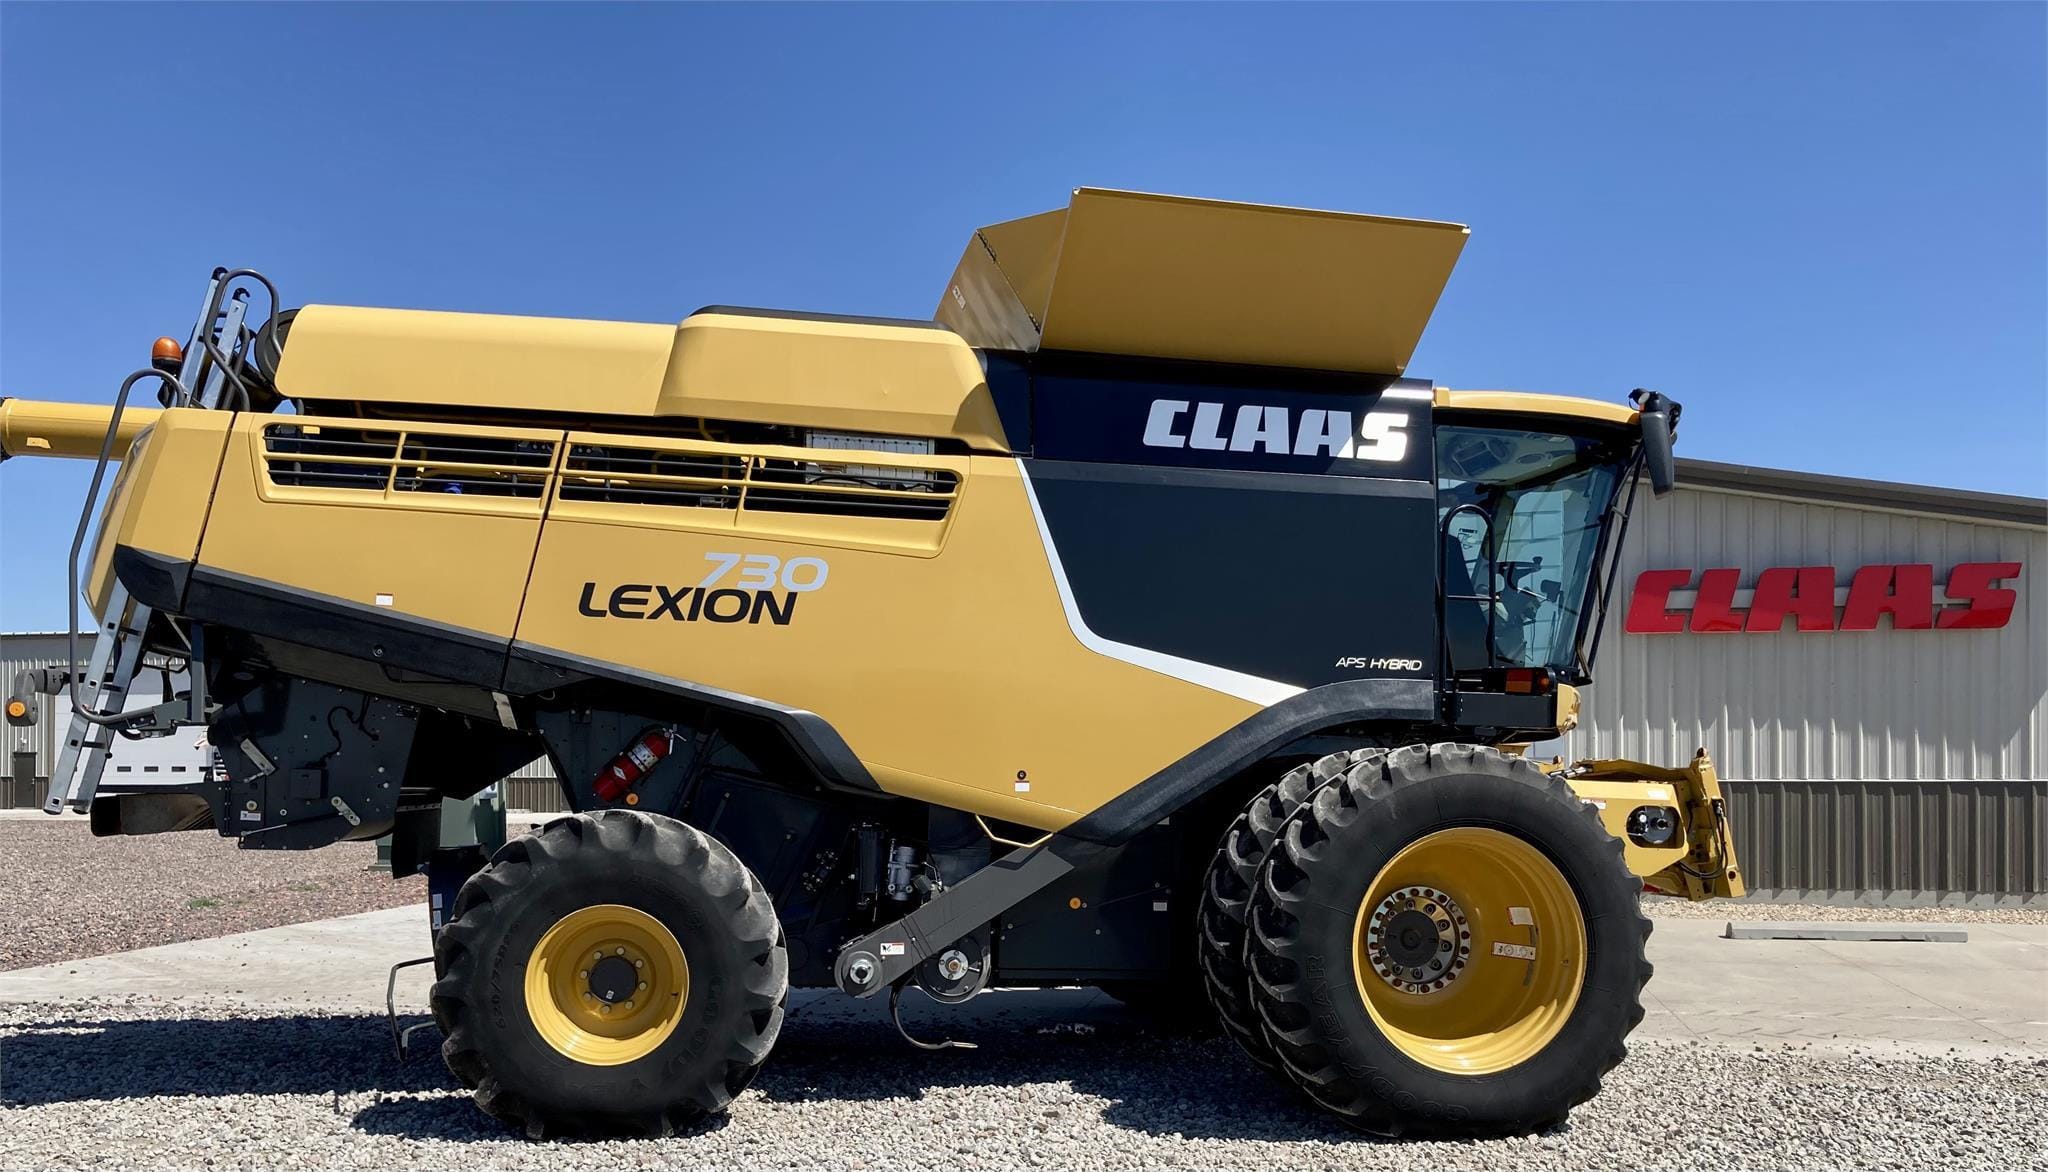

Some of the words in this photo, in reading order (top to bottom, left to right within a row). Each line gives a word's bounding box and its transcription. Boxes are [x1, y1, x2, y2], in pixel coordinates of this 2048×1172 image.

[1142, 399, 1409, 462] CLAAS
[698, 552, 829, 592] 730
[578, 582, 798, 625] LEXION
[1625, 562, 2023, 633] CLAAS
[1335, 657, 1367, 669] APS
[1369, 658, 1423, 671] HYBRID
